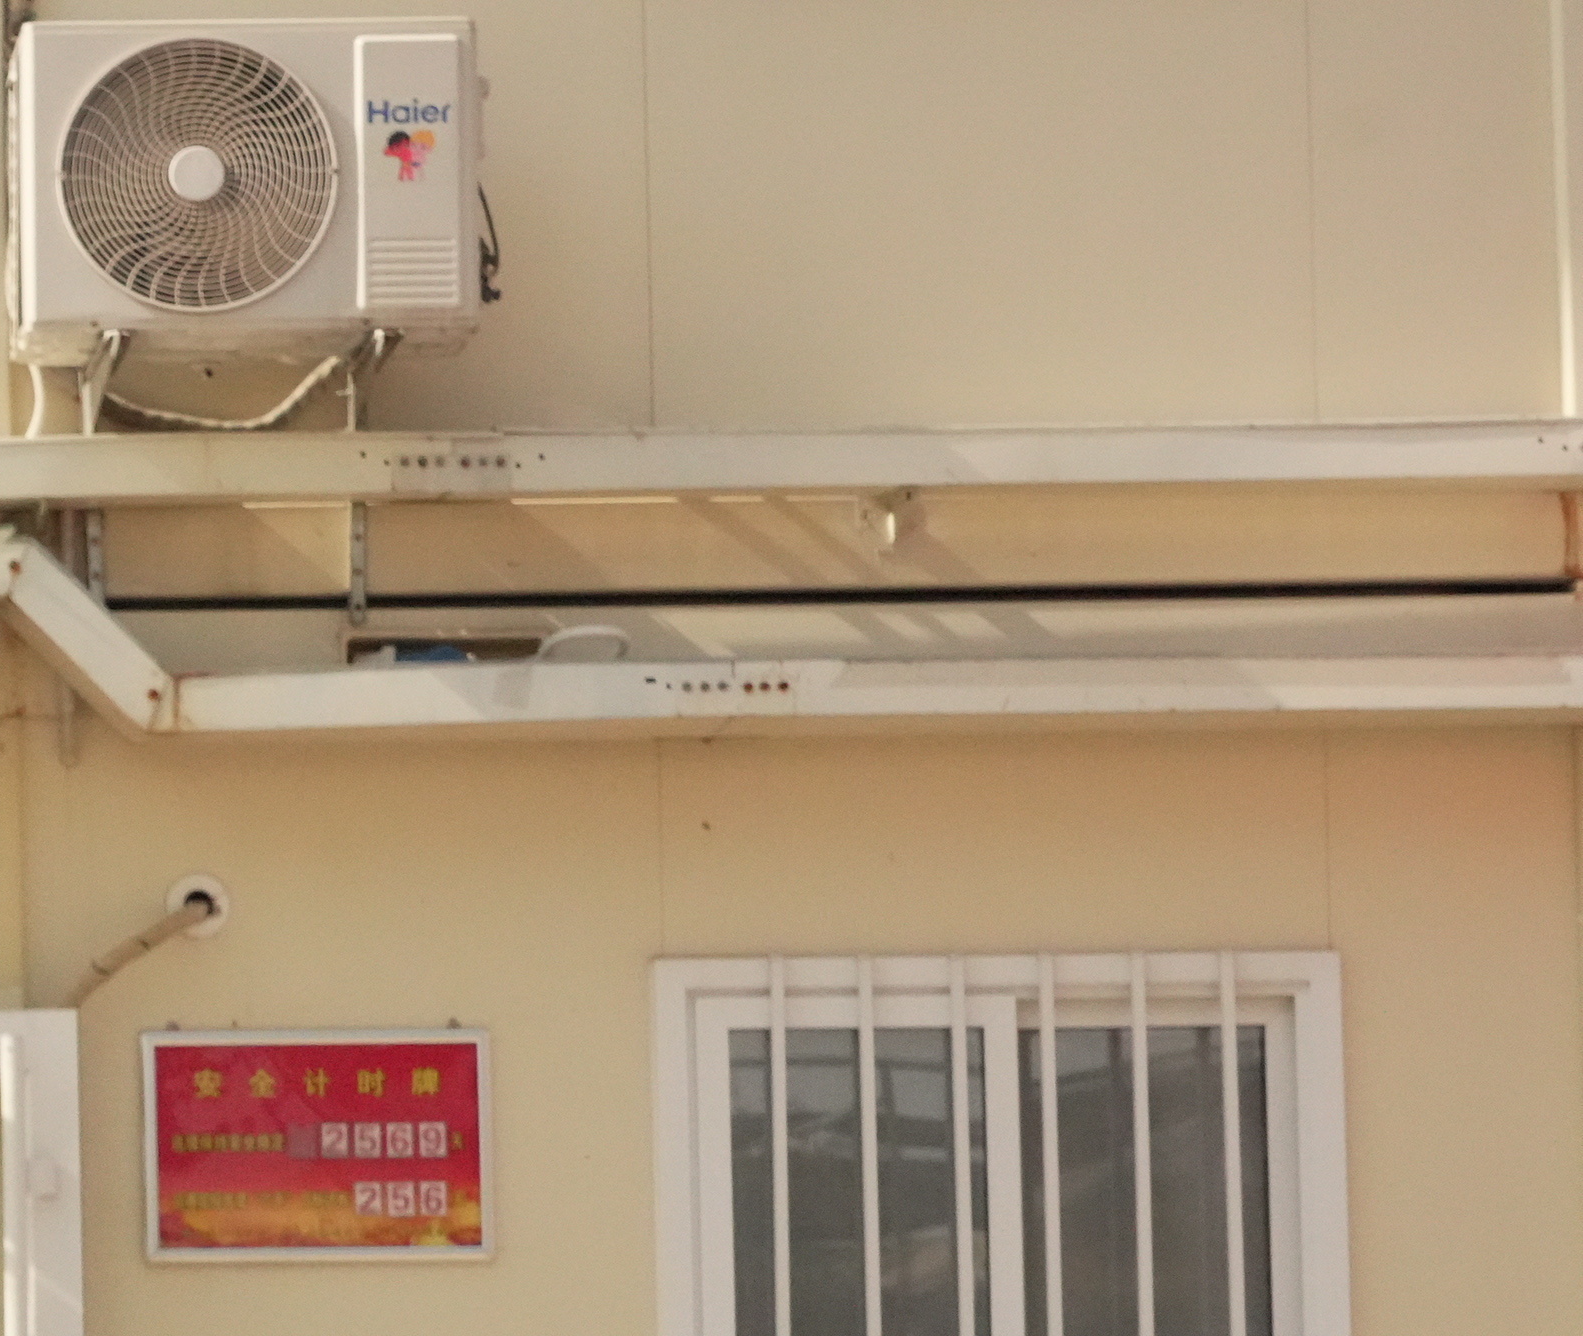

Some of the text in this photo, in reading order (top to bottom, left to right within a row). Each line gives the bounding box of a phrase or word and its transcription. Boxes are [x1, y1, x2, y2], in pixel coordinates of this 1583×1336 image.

[366, 99, 452, 124] Haier
[193, 1067, 441, 1098] 安全计时牌
[323, 1123, 445, 1157] 2569
[356, 1183, 446, 1215] 256
